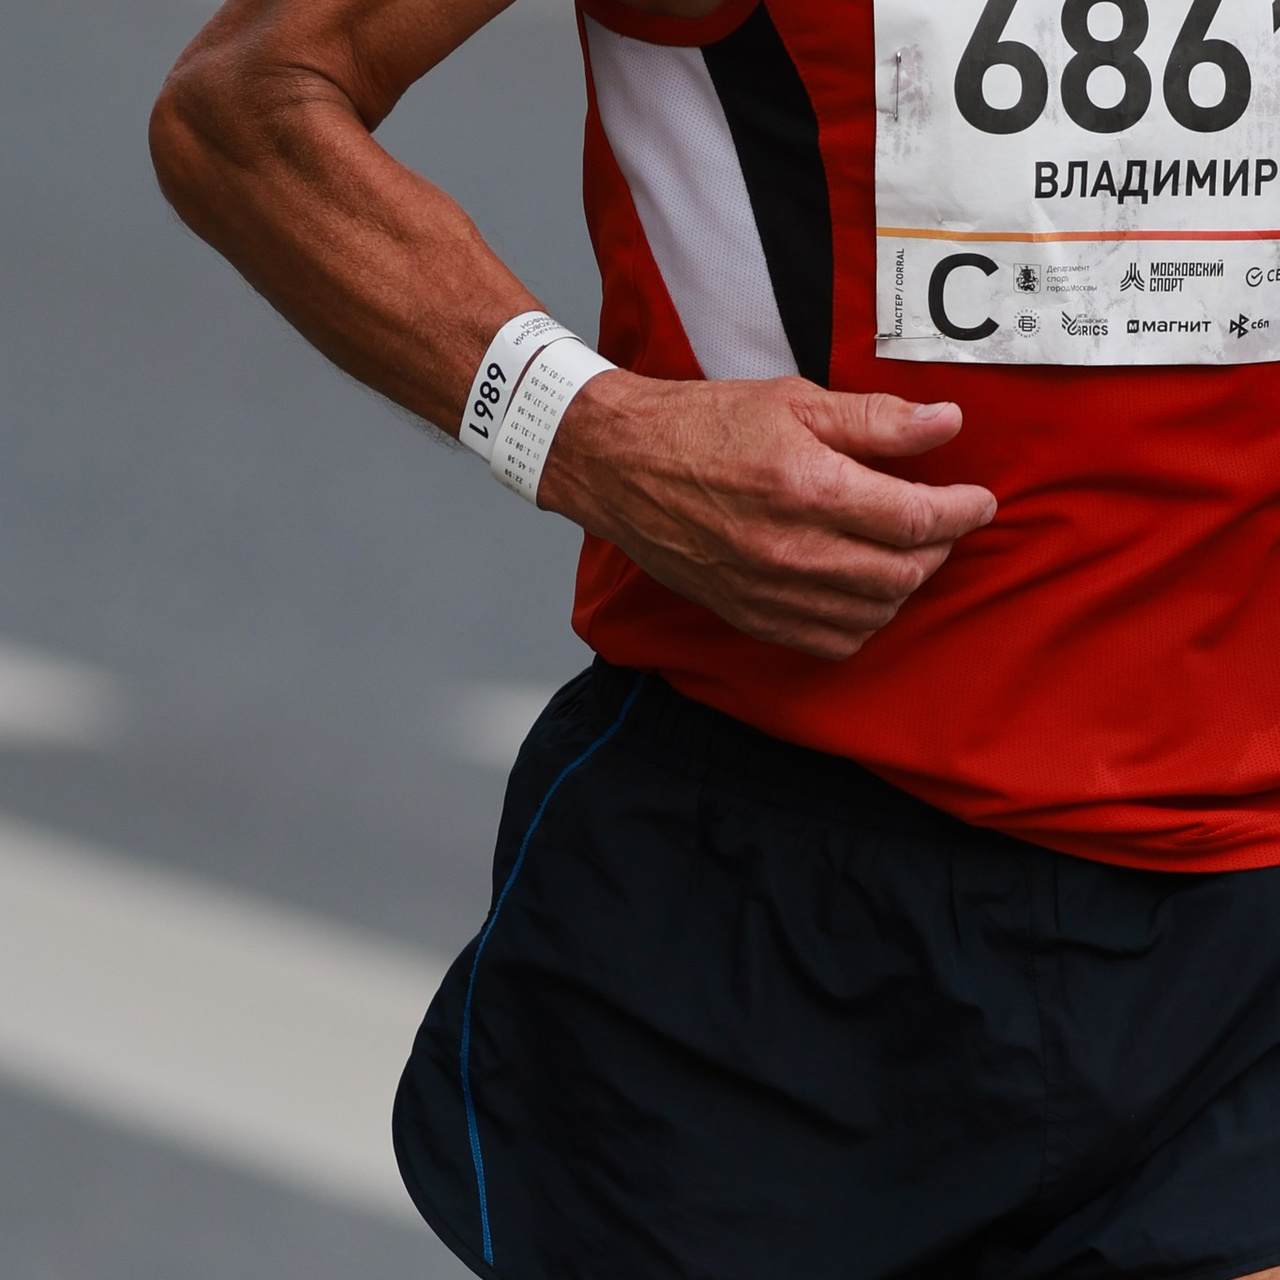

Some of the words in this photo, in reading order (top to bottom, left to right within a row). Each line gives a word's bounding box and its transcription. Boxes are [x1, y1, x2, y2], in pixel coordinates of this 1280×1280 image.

[1034, 159, 1278, 204] ВЛАДИМИР
[895, 248, 905, 286] CORRAL
[1150, 259, 1224, 277] МОСКОВСКИЙ
[1149, 278, 1184, 292] СПОРТ
[1142, 320, 1212, 333] магнит
[1251, 319, 1270, 329] сбп
[531, 377, 556, 397] 2:40:55
[469, 362, 507, 440] 6861
[524, 391, 549, 412] 2:17:55
